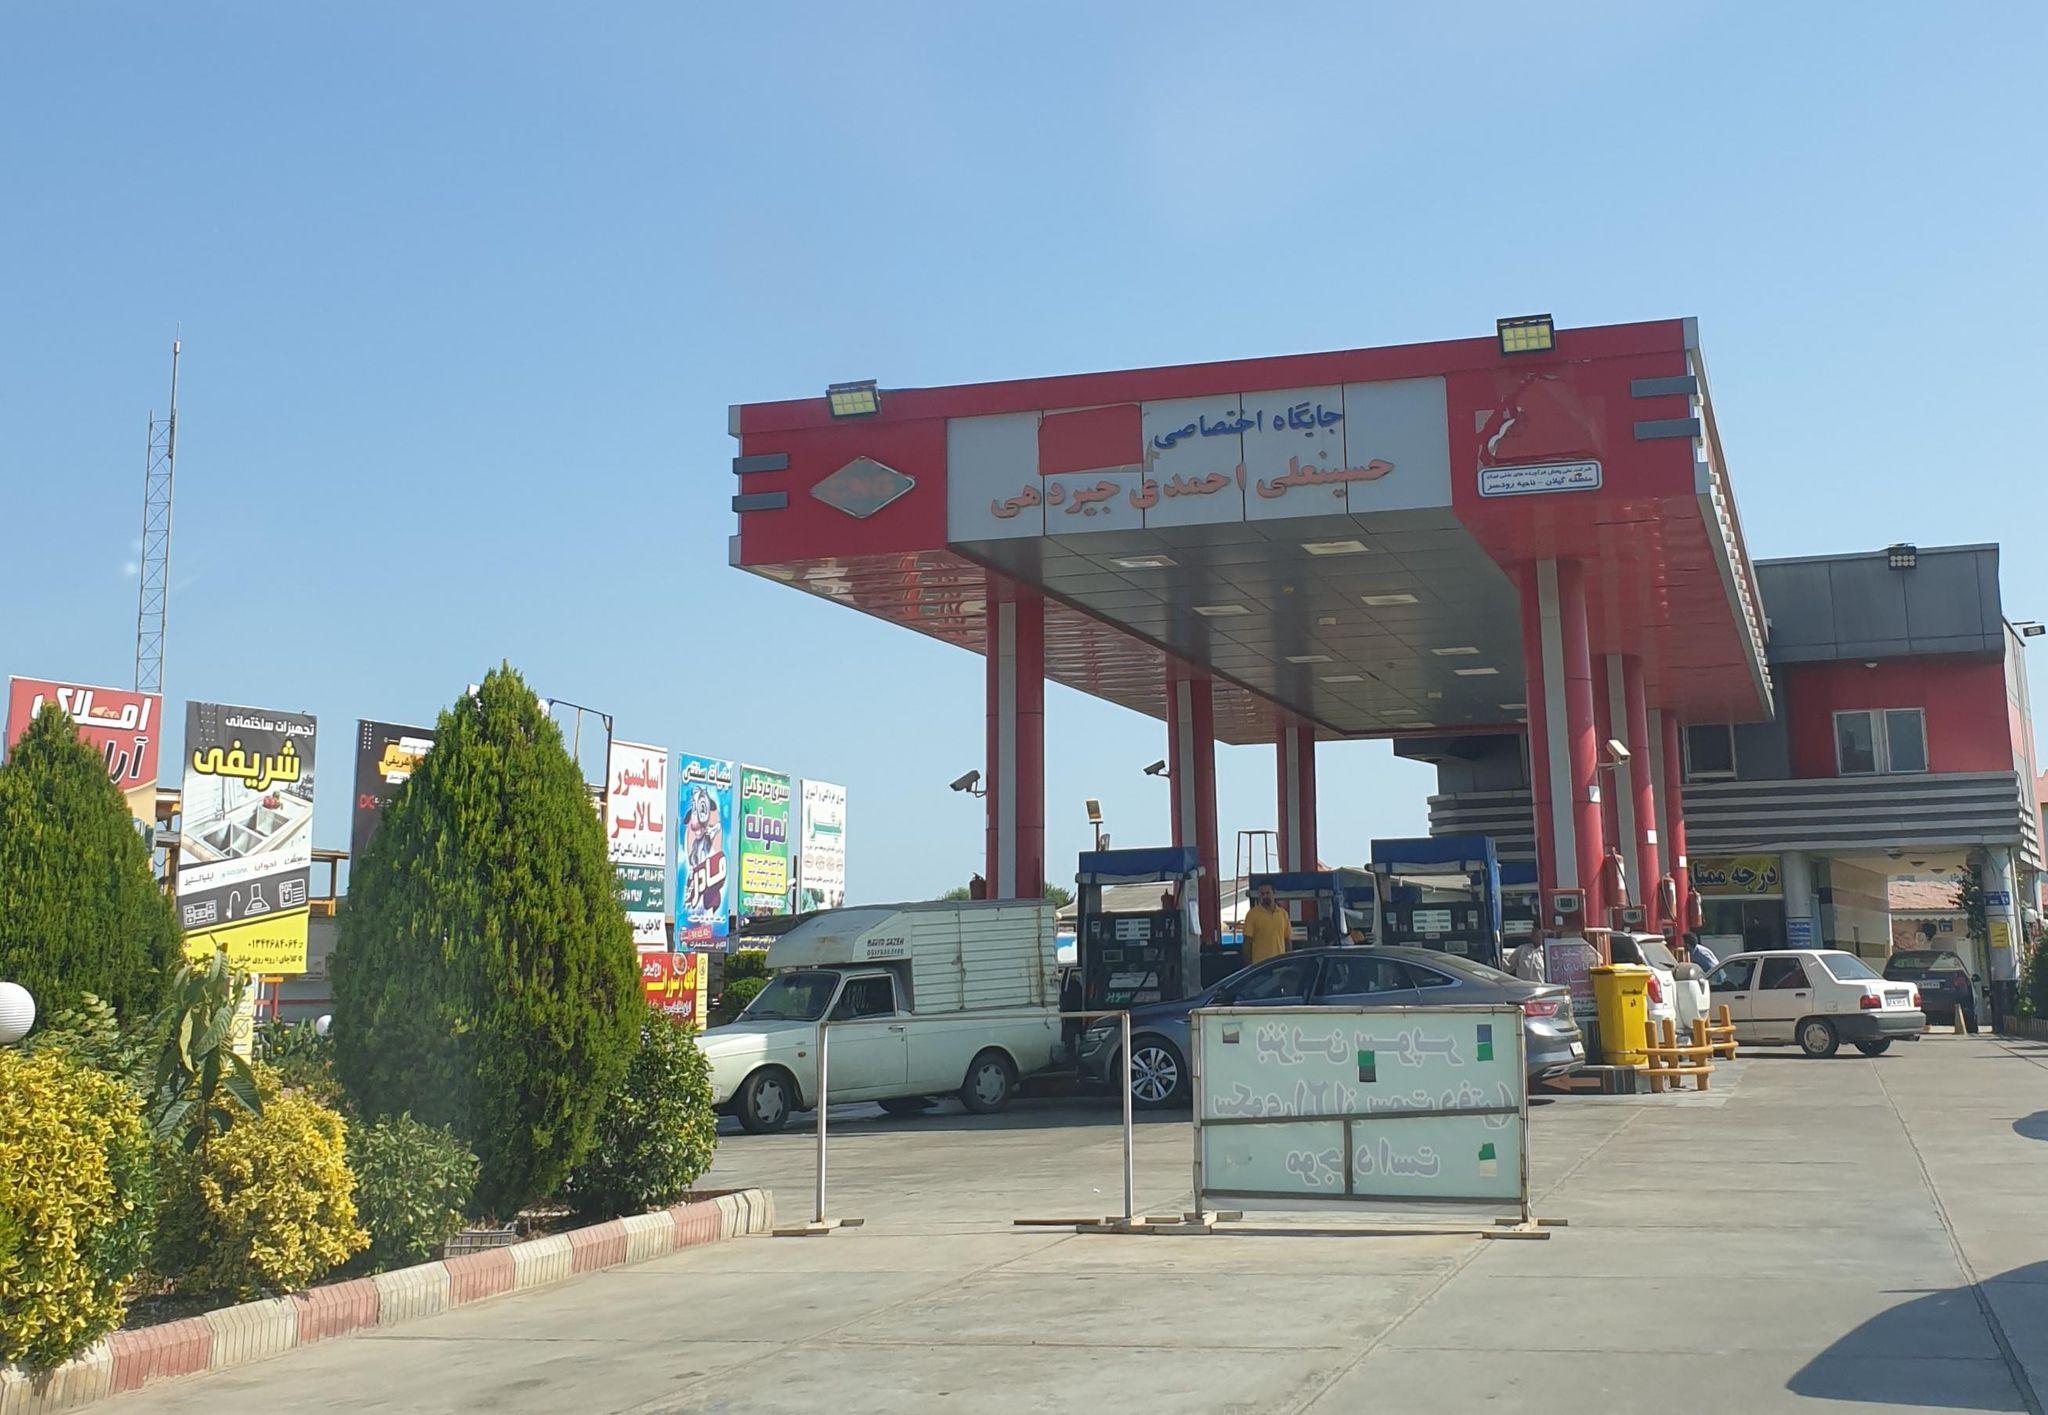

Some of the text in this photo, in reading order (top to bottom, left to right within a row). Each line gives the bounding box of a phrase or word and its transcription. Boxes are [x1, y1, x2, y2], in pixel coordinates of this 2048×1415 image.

[1154, 403, 1342, 450] جایگاه اختصاصی
[1129, 463, 1246, 510] احمدی
[1256, 449, 1395, 499] حسینعلی
[1487, 473, 1593, 491] منطقه گیلان ناحیه رودسر
[31, 687, 152, 730] املاک
[225, 715, 315, 738] تجهیزات ساختمانی
[192, 740, 301, 792] شریفی
[612, 758, 666, 796] آسانسور
[683, 761, 732, 790] لبنیات سنتی
[611, 801, 664, 841] بالابر
[745, 807, 788, 851] نمونه
[1691, 860, 1778, 893] درجه ممتا
[646, 967, 683, 998] رستوران
